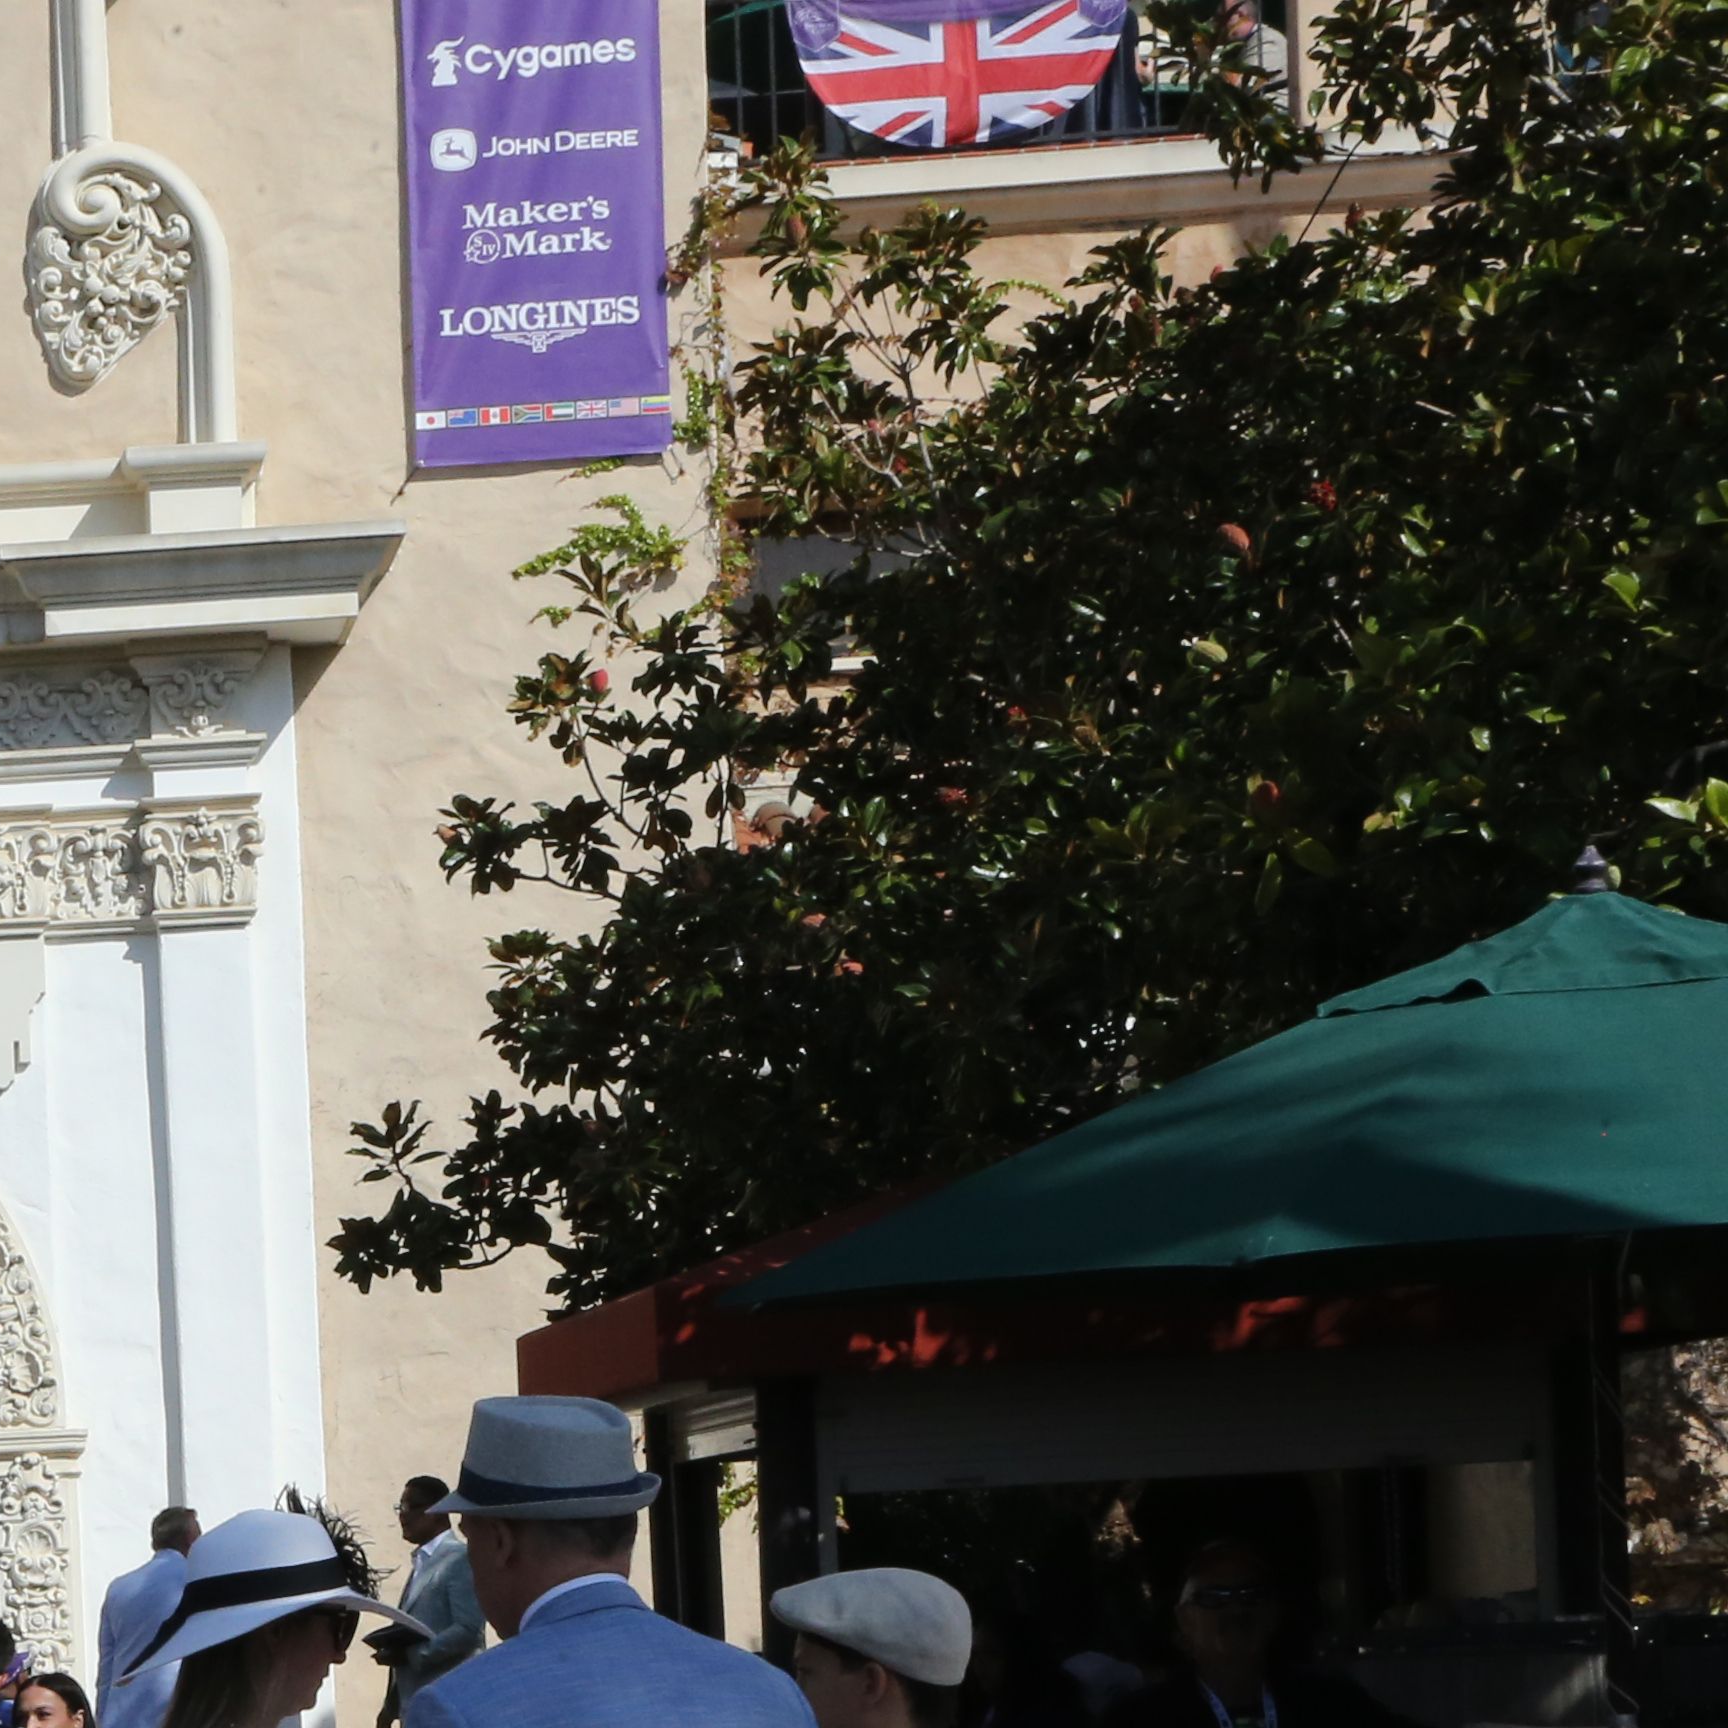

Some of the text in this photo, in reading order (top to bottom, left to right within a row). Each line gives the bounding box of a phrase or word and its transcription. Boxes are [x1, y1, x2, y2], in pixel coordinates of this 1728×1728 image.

[464, 38, 636, 80] Cygames
[482, 129, 639, 159] JOHN DEERE
[461, 195, 611, 229] Maker's
[501, 226, 611, 259] Mark
[440, 296, 640, 337] LONGINES
